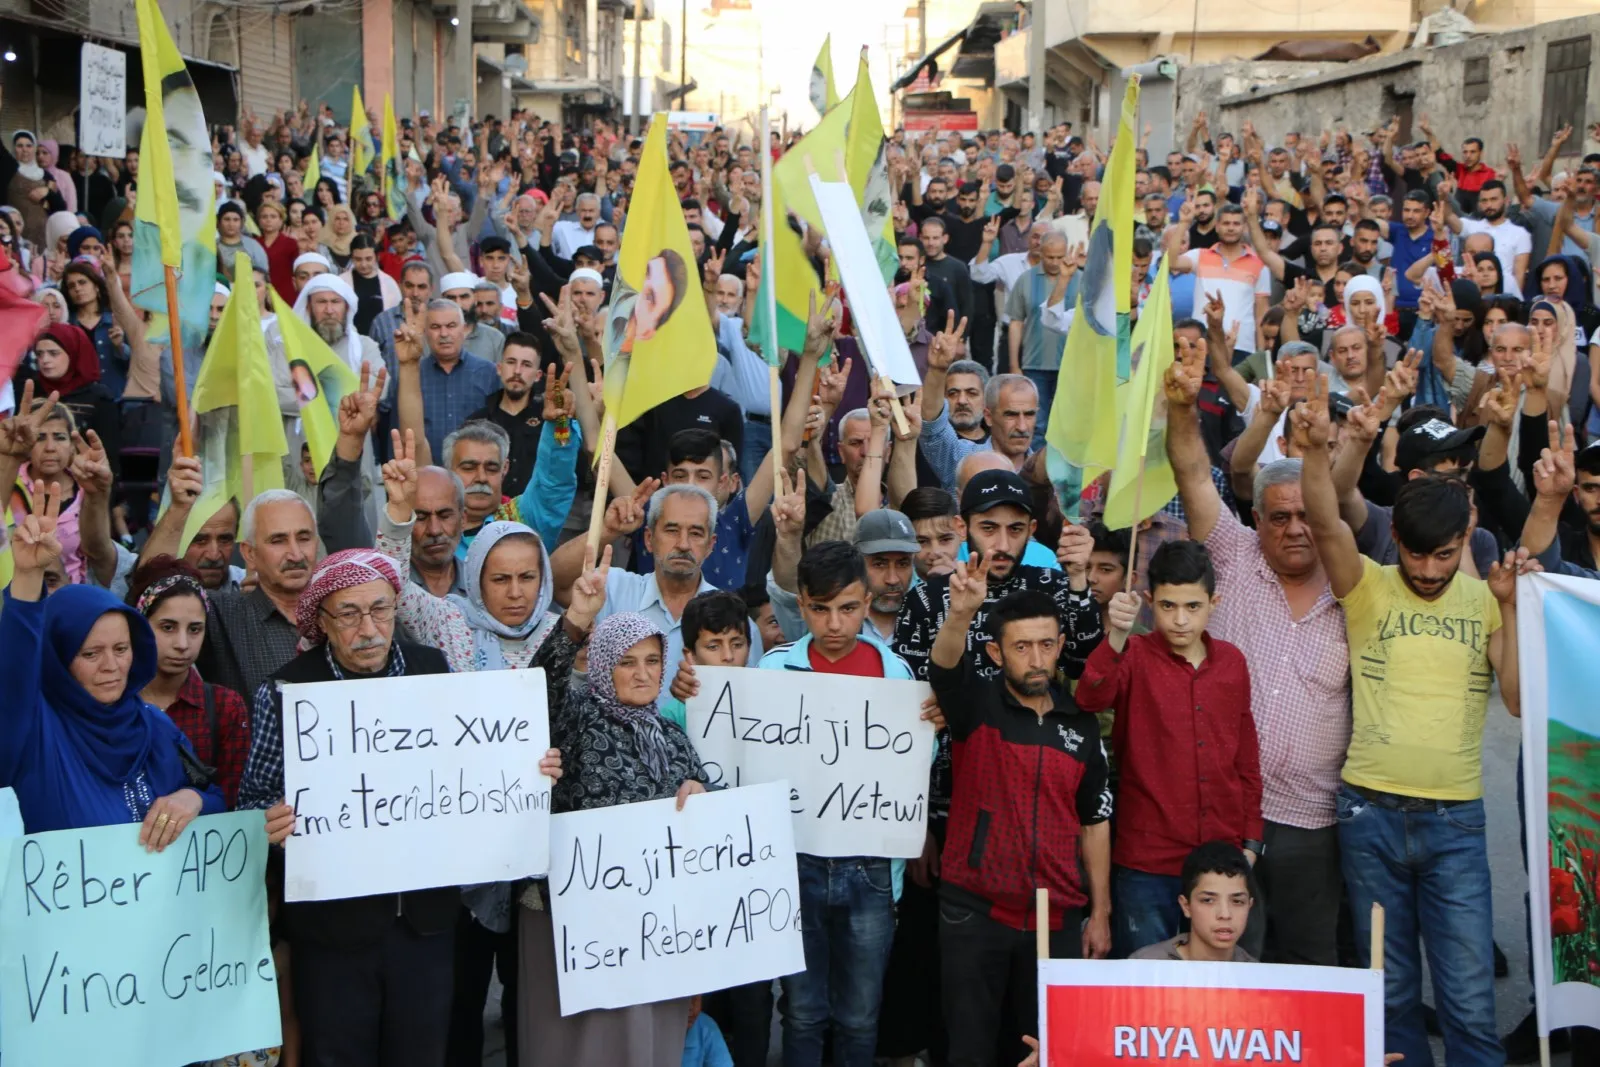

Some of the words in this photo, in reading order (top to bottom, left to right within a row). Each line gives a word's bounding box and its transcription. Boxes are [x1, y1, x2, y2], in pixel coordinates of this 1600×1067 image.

[1379, 610, 1482, 654] LACOSTE
[295, 699, 333, 761] Bi
[351, 700, 438, 753] hêza
[865, 700, 913, 754] bo
[817, 781, 924, 821] Netewî
[23, 839, 152, 916] Rêber
[176, 828, 248, 896] APO
[558, 833, 632, 896] Na
[641, 904, 718, 961] Rêber
[23, 951, 146, 1023] Vîna
[1114, 1026, 1200, 1058] RIYA
[1207, 1028, 1302, 1061] WAN
